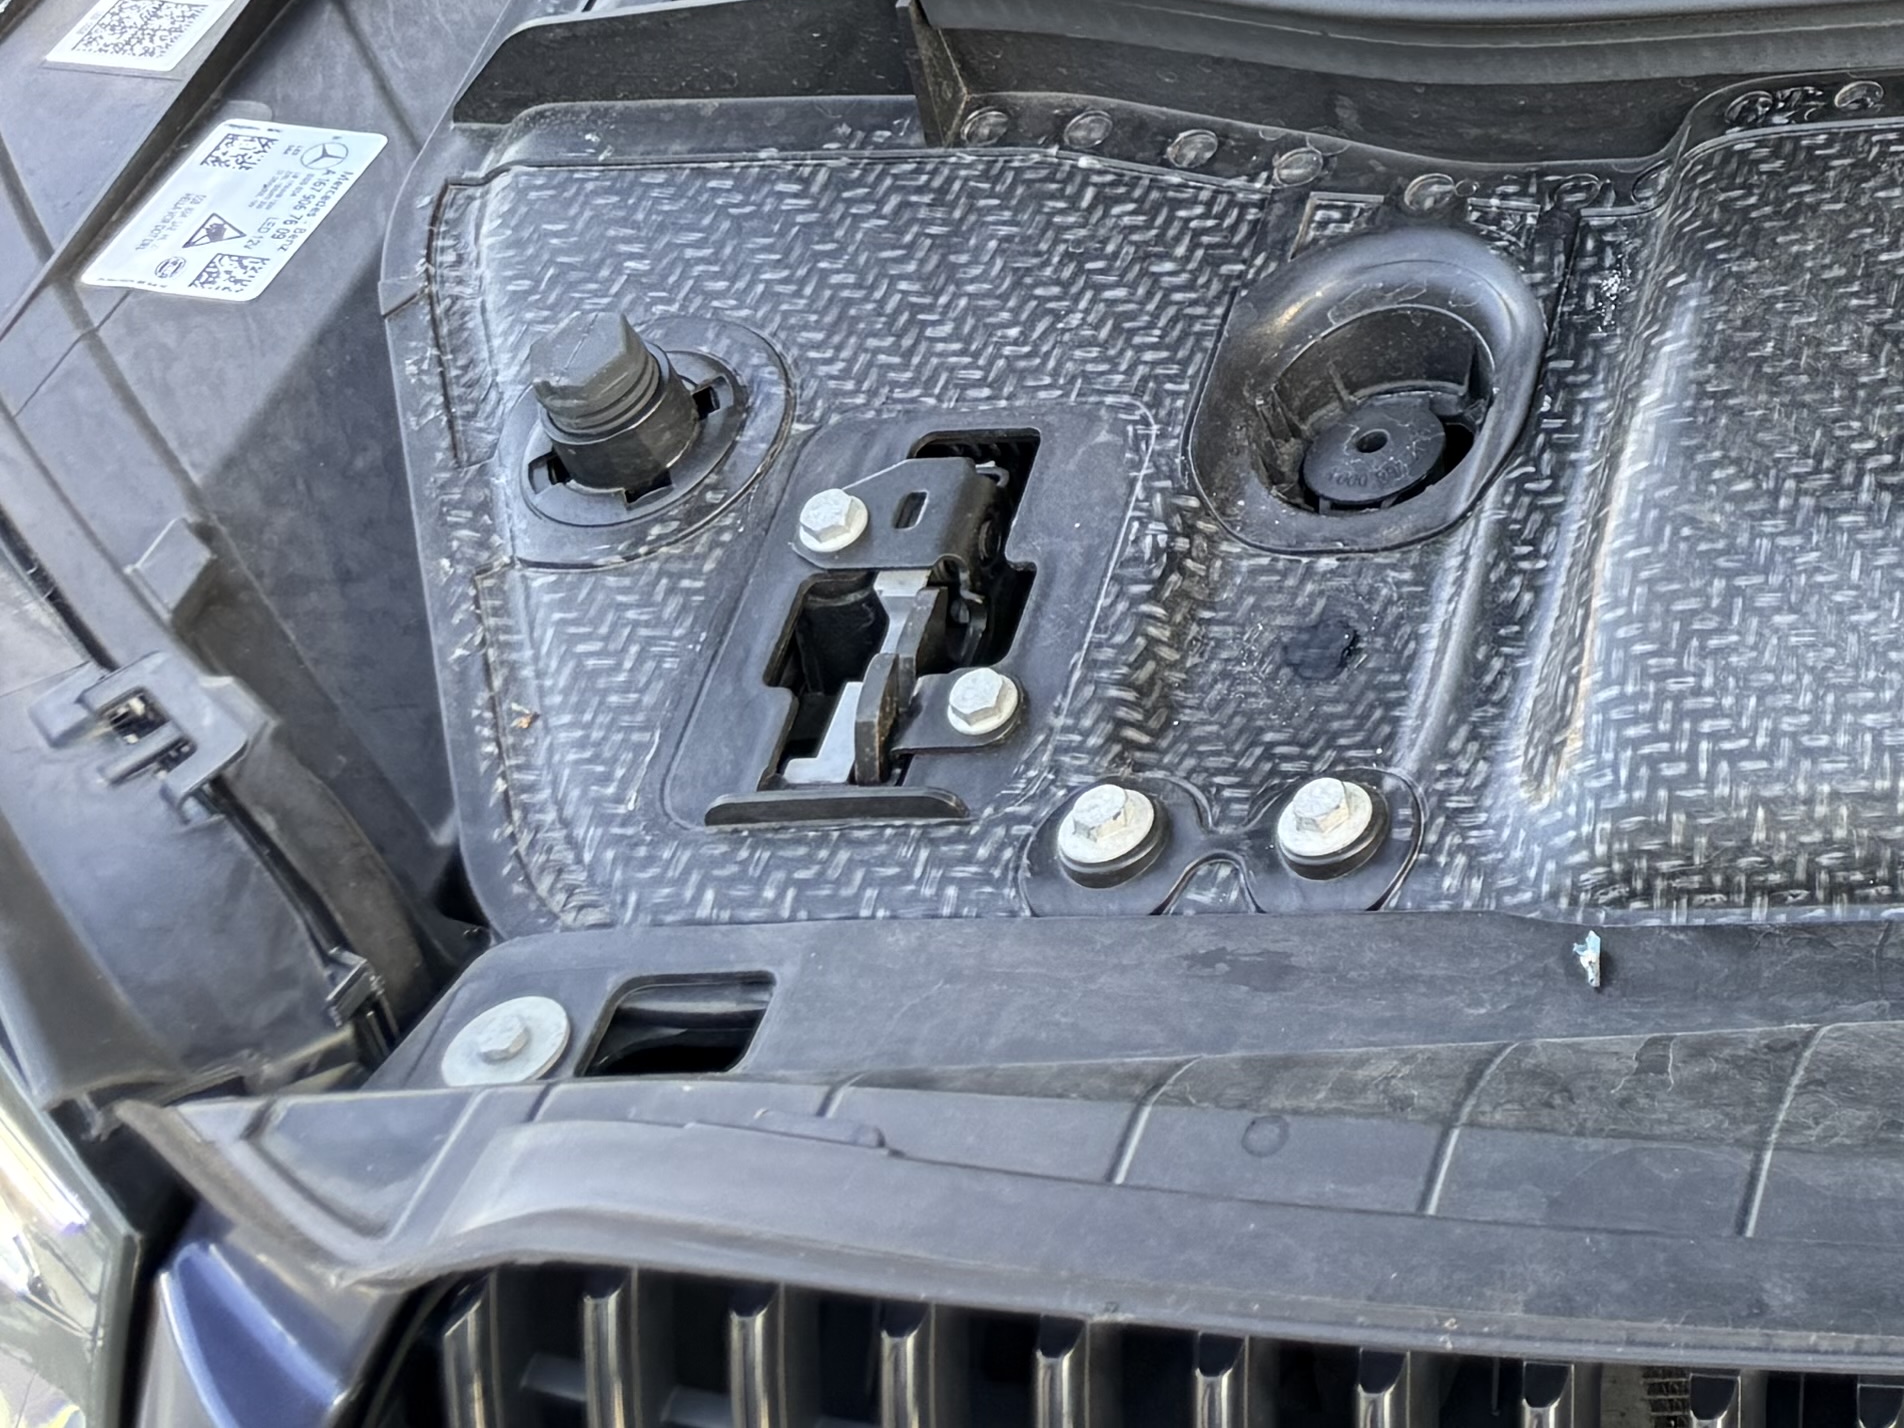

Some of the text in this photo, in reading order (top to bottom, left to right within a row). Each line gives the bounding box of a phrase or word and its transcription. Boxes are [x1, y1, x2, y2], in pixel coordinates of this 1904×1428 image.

[310, 178, 330, 192] 167
[293, 194, 316, 210] 906
[307, 171, 353, 217] Mercedes
[257, 217, 277, 233] LED
[277, 228, 306, 251] Benz
